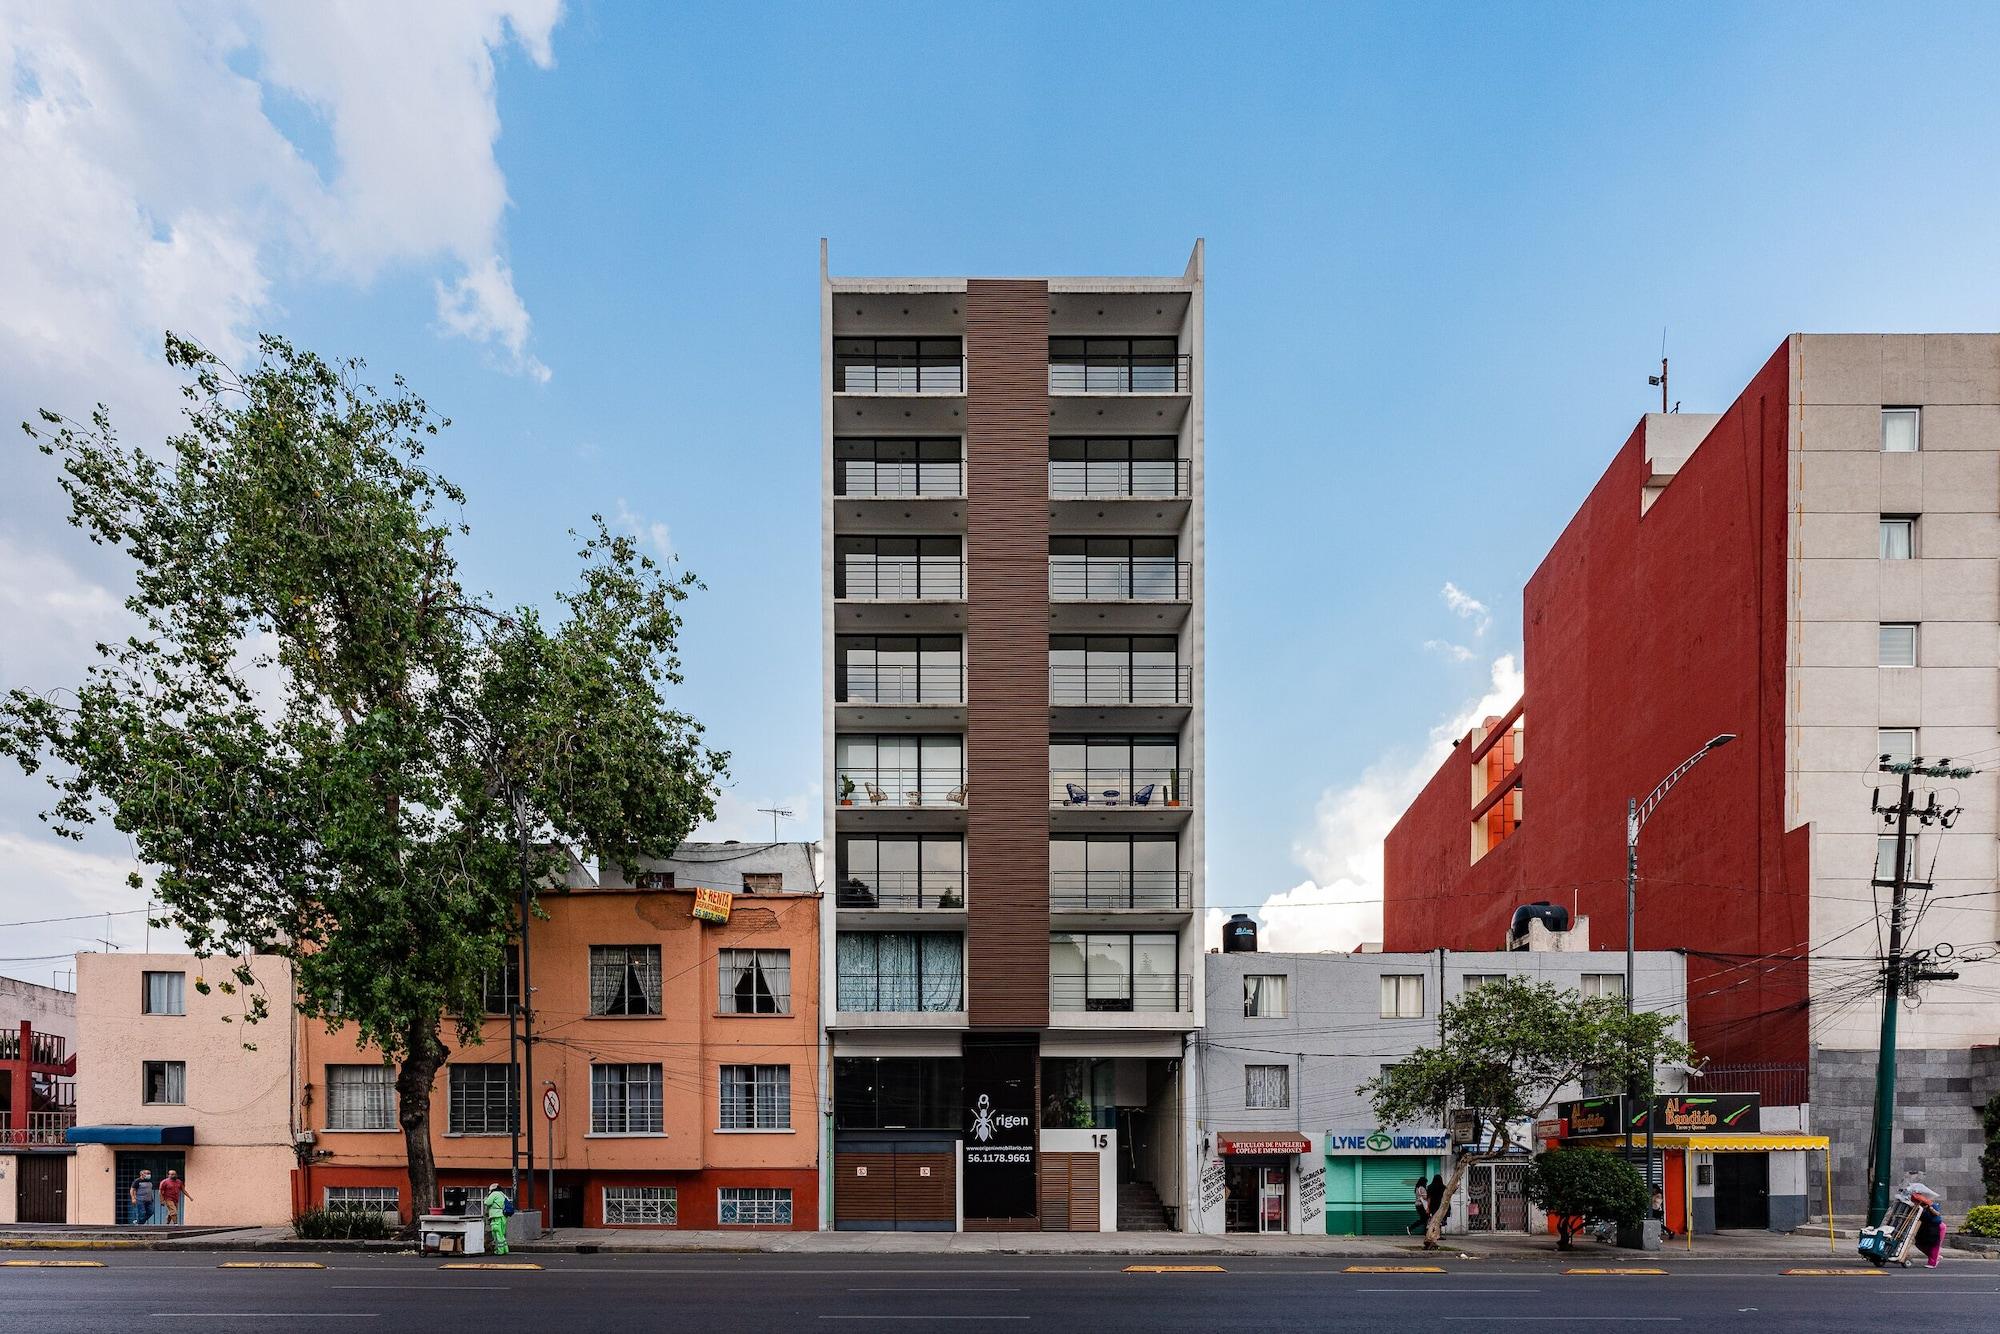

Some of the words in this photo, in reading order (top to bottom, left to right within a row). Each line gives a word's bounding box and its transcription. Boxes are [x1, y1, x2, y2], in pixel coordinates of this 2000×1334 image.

[697, 887, 707, 901] SE
[708, 890, 730, 907] RENTA
[696, 900, 729, 915] DEPARTAMENTO
[1667, 1098, 1679, 1112] Al
[1665, 1109, 1717, 1125] Bandido
[1091, 1134, 1108, 1148] 15
[1332, 1136, 1366, 1149] LYNE
[1393, 1136, 1447, 1149] UNIFORMES
[967, 1153, 1031, 1162] 56.1178.9661
